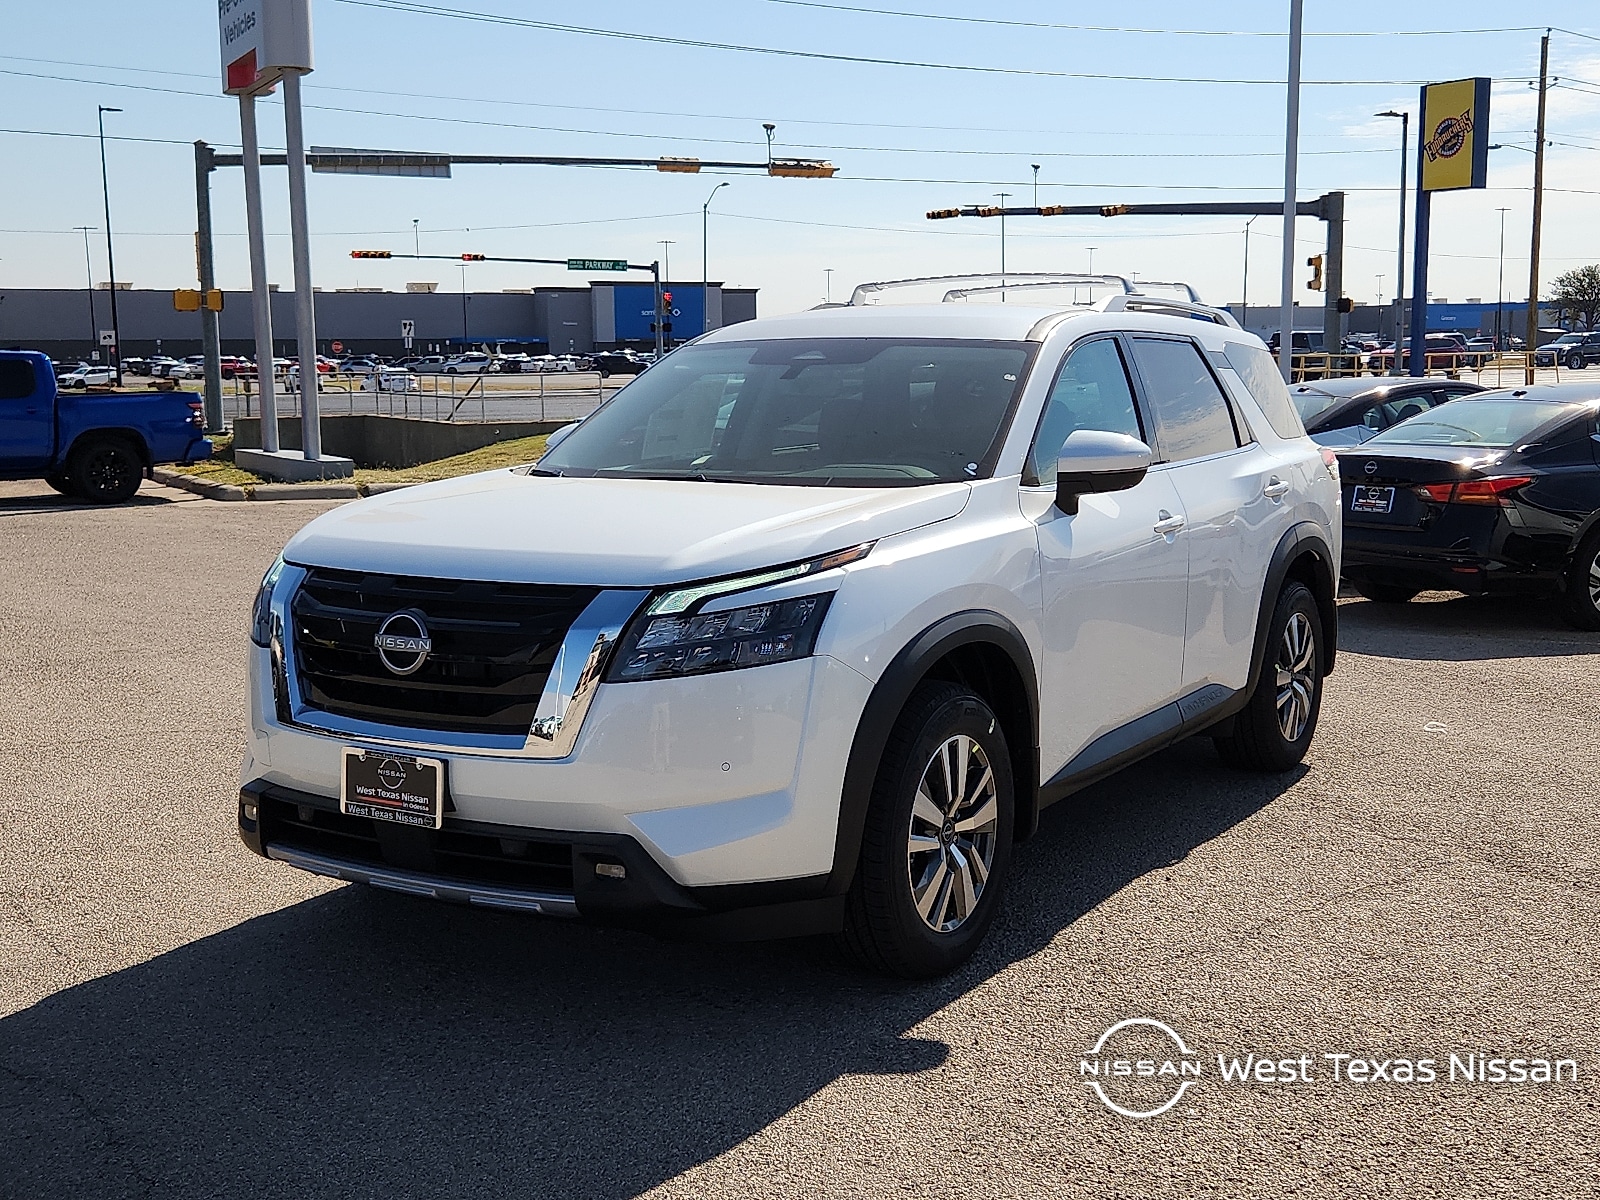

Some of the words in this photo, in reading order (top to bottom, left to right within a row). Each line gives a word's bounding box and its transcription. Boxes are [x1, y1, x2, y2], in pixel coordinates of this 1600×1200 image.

[224, 11, 256, 45] Vehicles
[1425, 111, 1473, 162] FUDDRUCKERS
[584, 260, 614, 270] PARKWAY
[374, 635, 430, 650] NISSAN
[377, 768, 407, 779] NISSAN
[355, 784, 376, 796] West
[377, 788, 400, 800] Texas
[401, 792, 429, 804] Nissan
[347, 803, 369, 816] West
[370, 807, 394, 820] Texas
[395, 811, 424, 825] Nissan
[409, 802, 430, 812] Odessa
